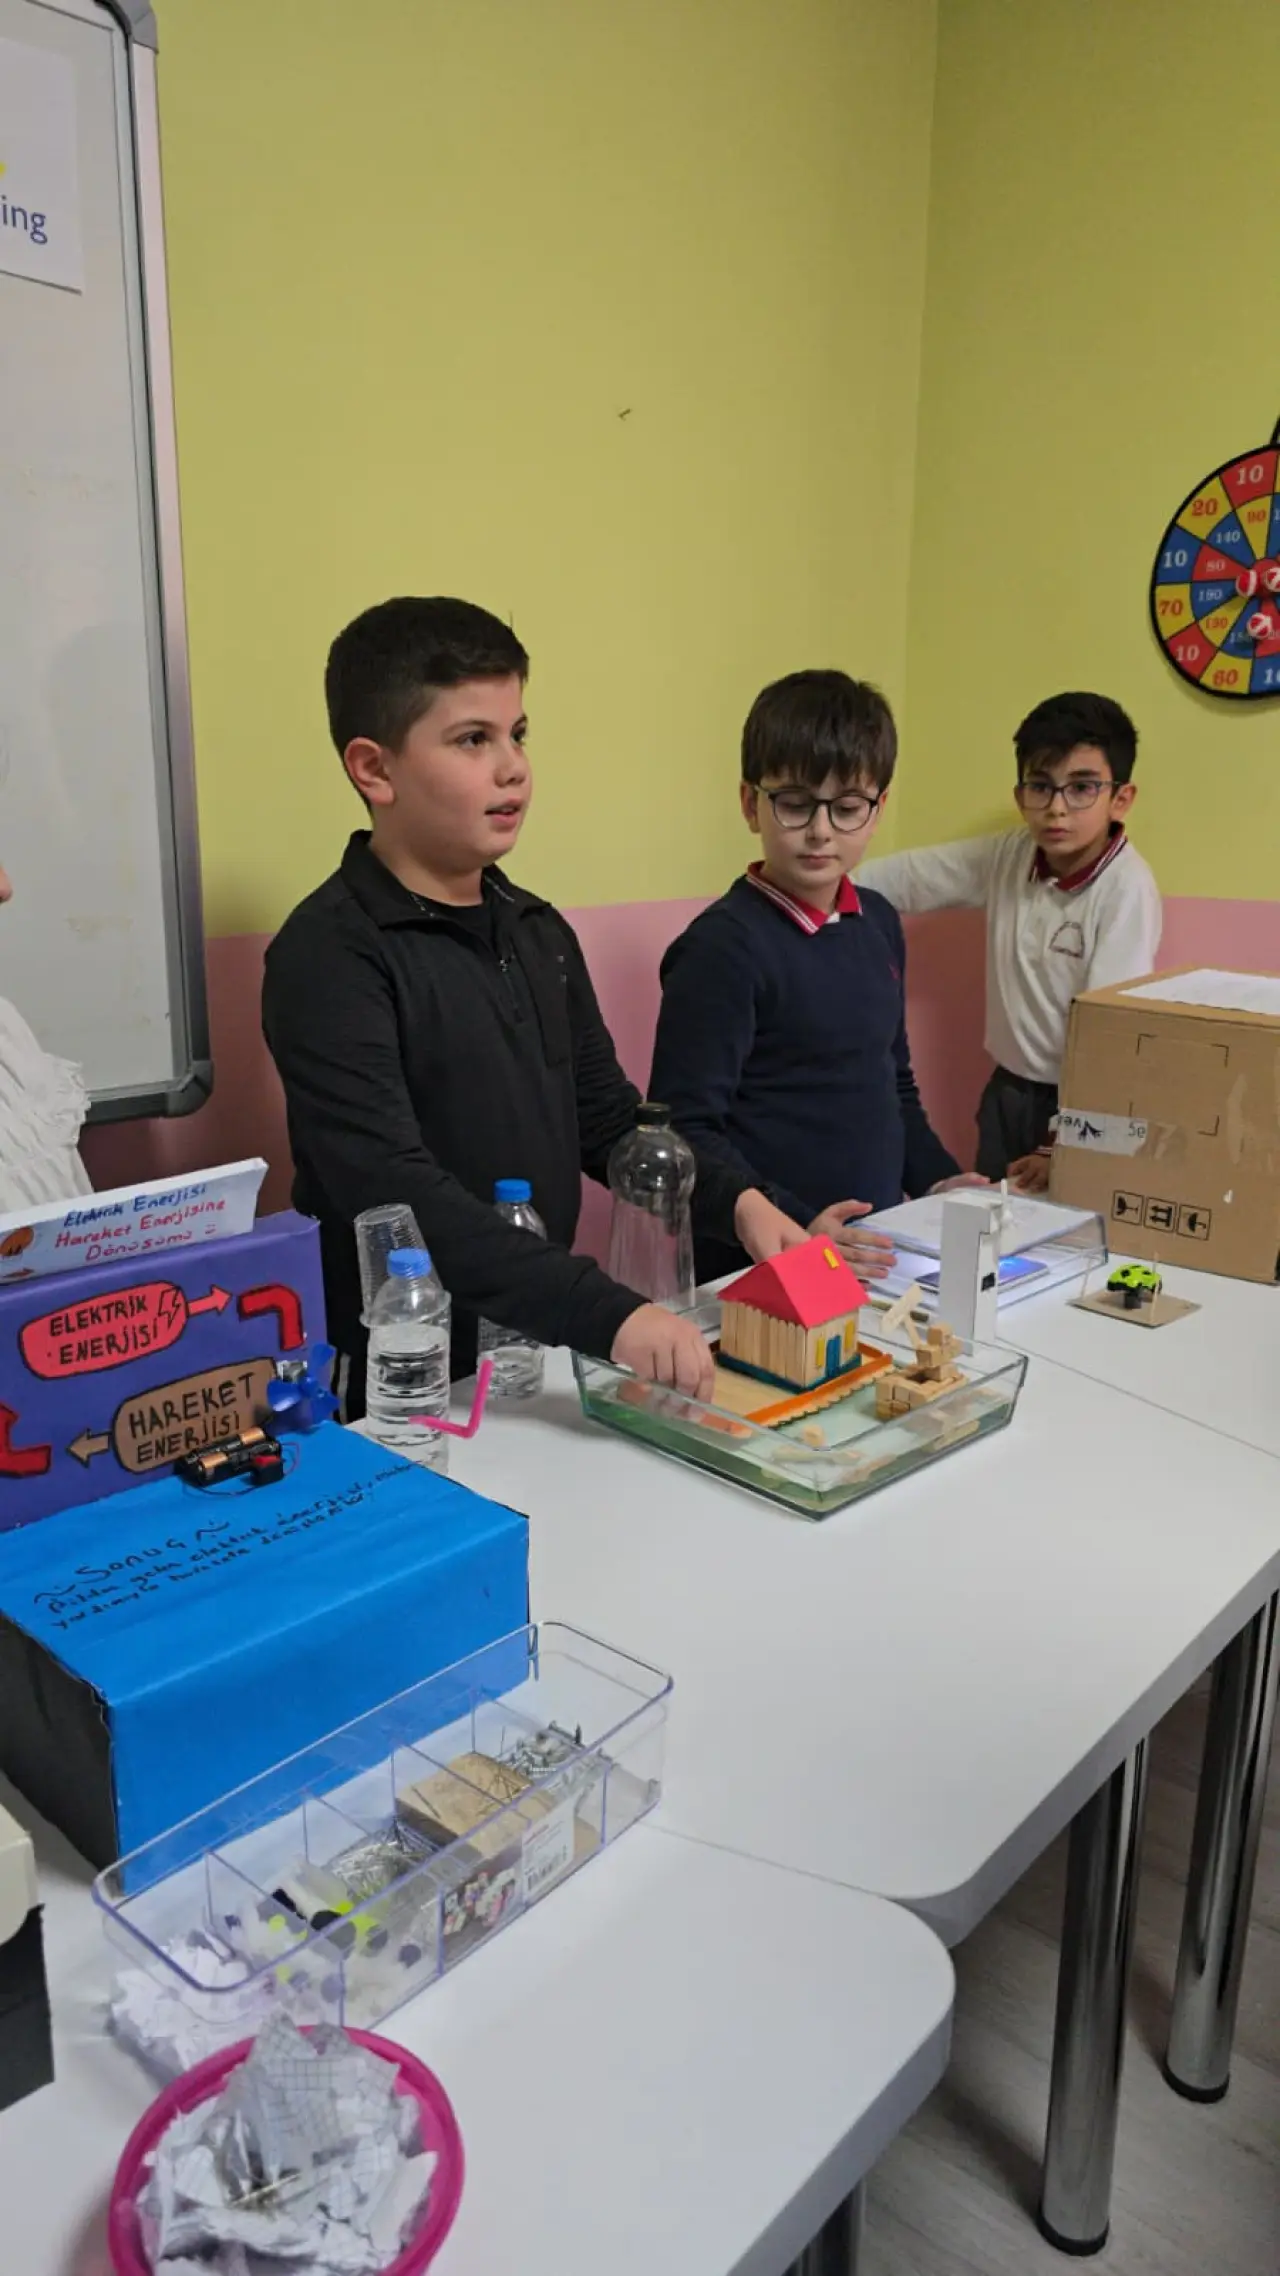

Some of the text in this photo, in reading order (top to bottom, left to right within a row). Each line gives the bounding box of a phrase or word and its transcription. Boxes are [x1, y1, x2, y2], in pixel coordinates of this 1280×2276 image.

[1236, 464, 1264, 485] 10
[1191, 498, 1219, 517] 20
[1163, 549, 1189, 569] 10
[1158, 598, 1184, 617] 70
[1176, 644, 1200, 664] 10
[1264, 667, 1280, 684] 1
[129, 1371, 255, 1439] HAREKET
